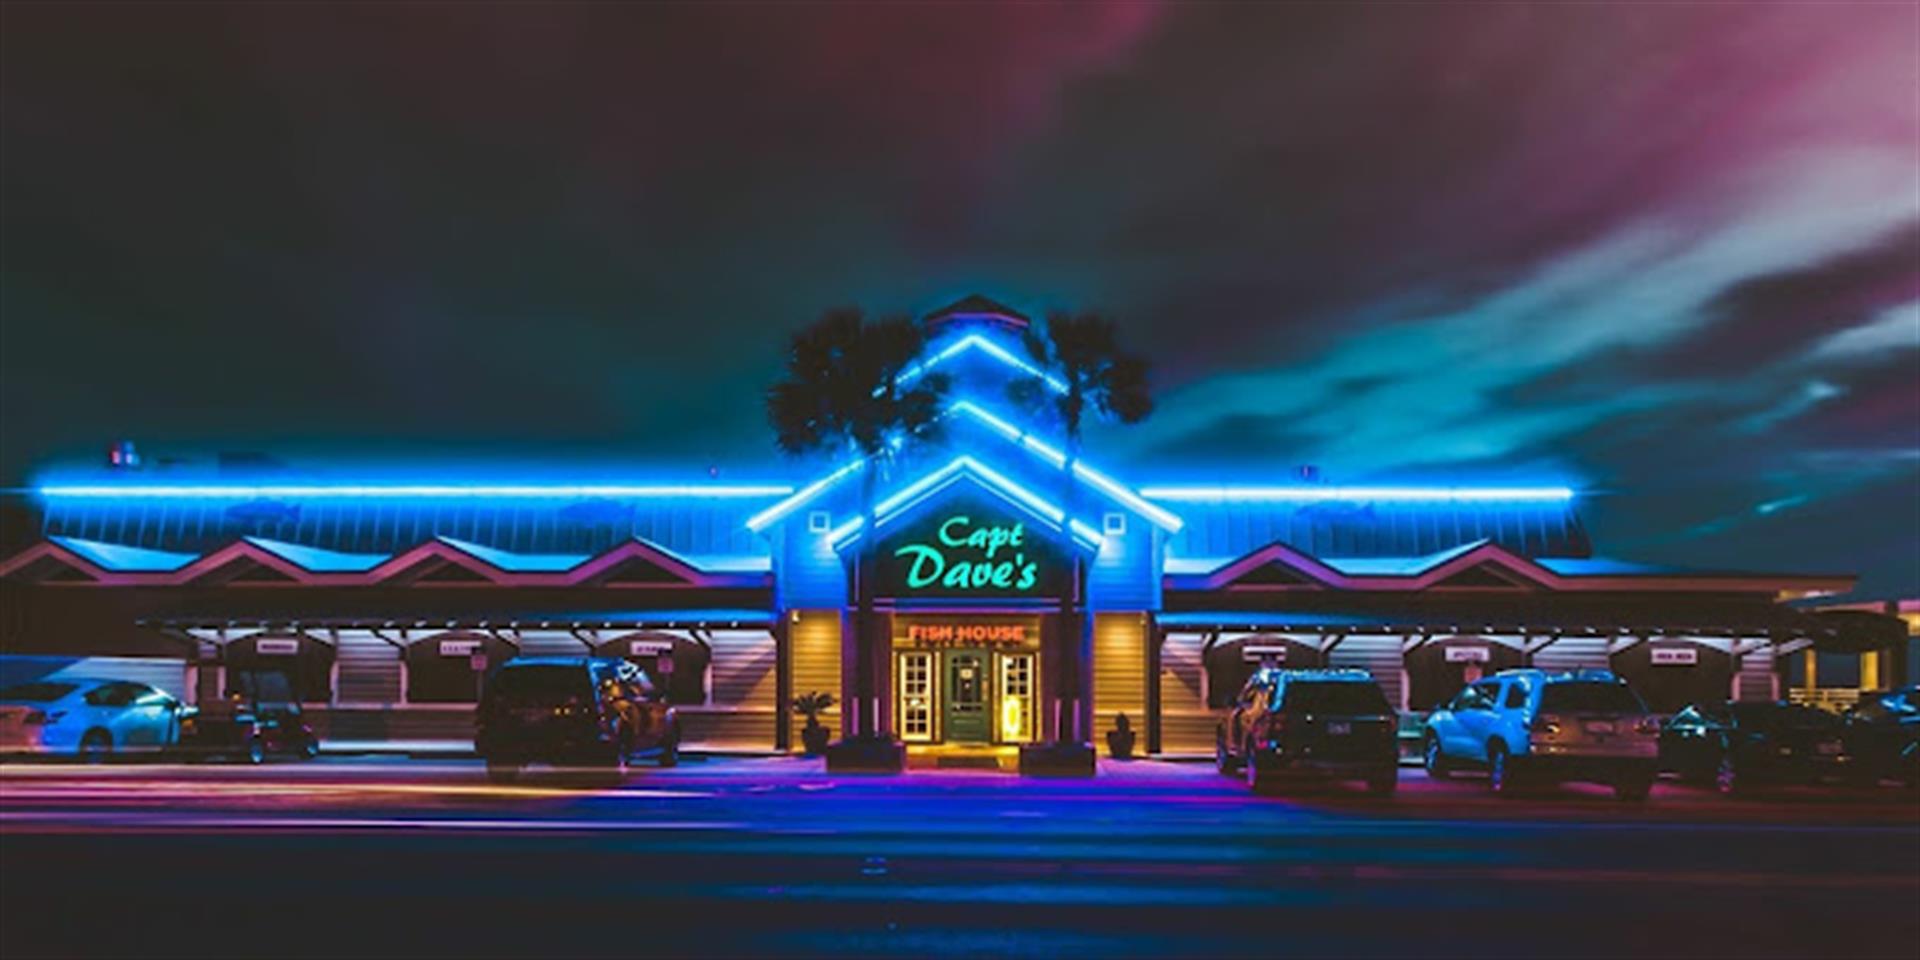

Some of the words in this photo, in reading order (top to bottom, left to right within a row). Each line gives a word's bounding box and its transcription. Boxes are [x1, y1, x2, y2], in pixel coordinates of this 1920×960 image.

[938, 516, 1024, 558] Capt
[895, 544, 1037, 589] Dave's
[909, 625, 953, 641] FISH
[956, 625, 1025, 641] HOUSE
